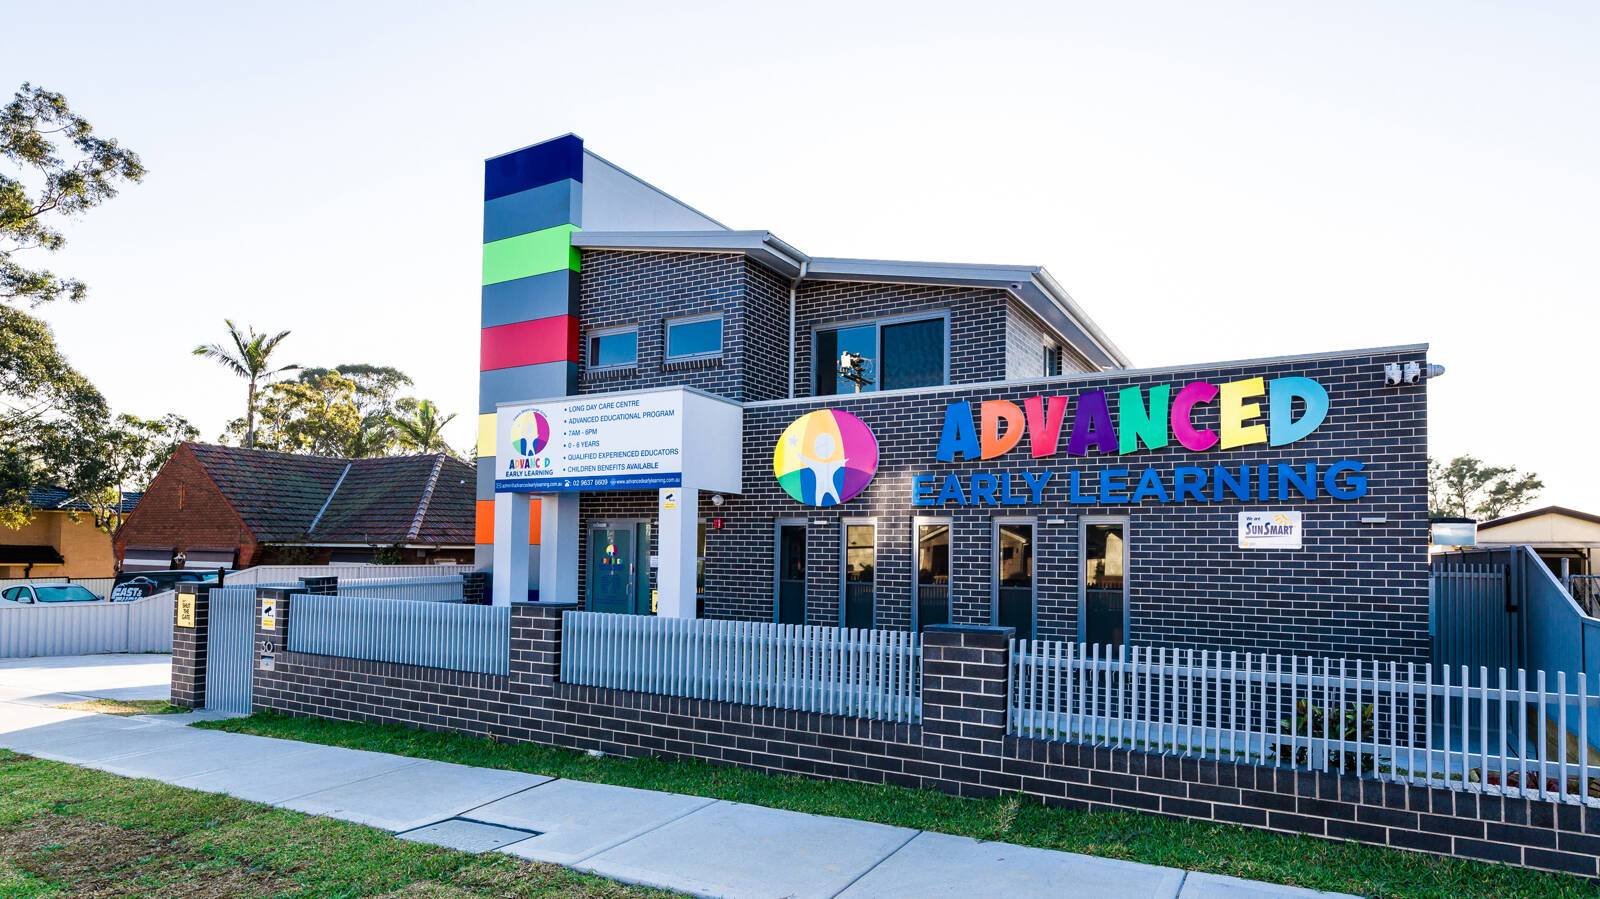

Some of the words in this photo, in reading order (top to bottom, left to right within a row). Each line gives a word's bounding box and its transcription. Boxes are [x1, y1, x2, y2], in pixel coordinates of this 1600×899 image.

[568, 405, 585, 413] LONG
[599, 402, 615, 410] CARE
[615, 400, 640, 409] CENTRE
[568, 415, 600, 425] ADVANCED
[600, 412, 641, 422] EDUCATIONAL
[642, 409, 675, 418] PROGRAM
[935, 376, 1330, 463] ADVANCED
[580, 440, 600, 448] YEARS
[567, 452, 597, 461] QUALIFIED
[598, 450, 640, 459] EXPERIENCED
[640, 448, 679, 457] EDUCATORS
[524, 469, 554, 477] LEARNING
[567, 464, 596, 473] CHILDREN
[597, 463, 626, 472] BENEFITS
[626, 462, 659, 470] AVAILABLE
[912, 470, 1054, 506] EARLY
[1069, 459, 1368, 505] LEARNING
